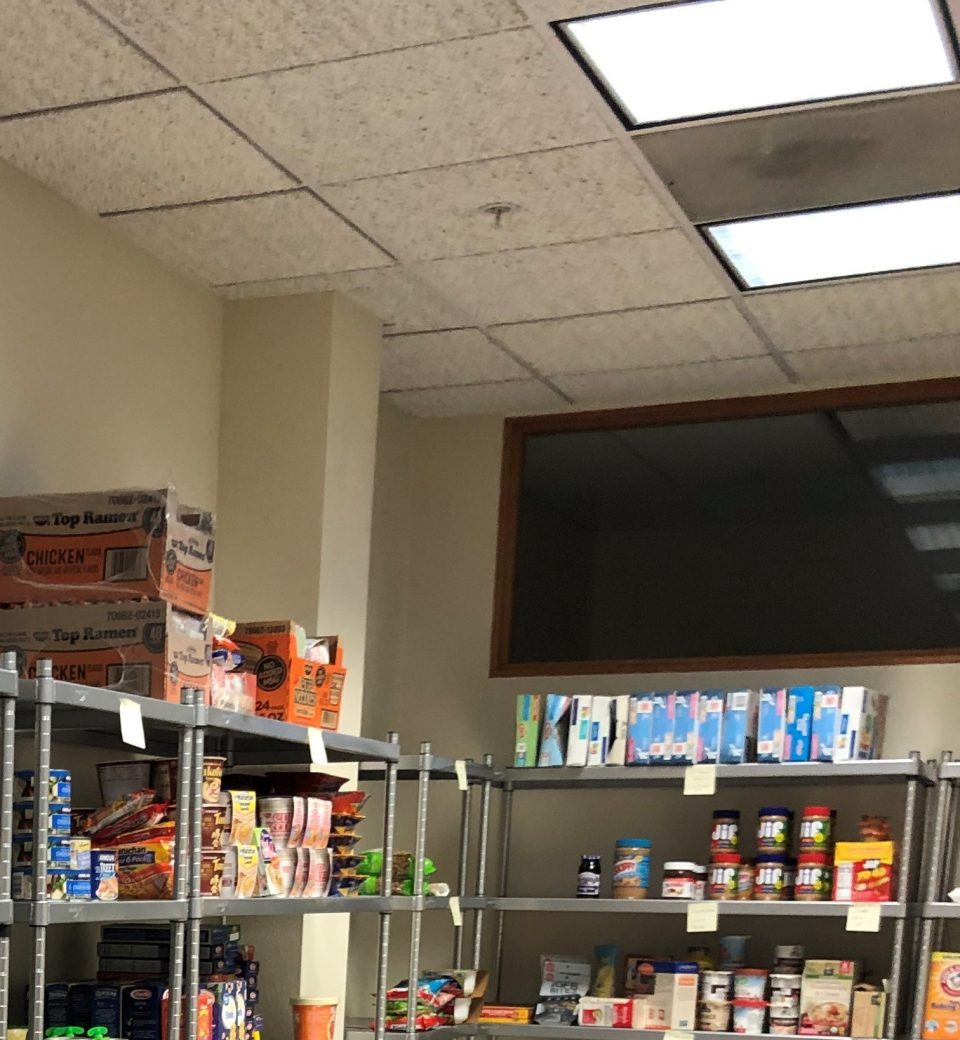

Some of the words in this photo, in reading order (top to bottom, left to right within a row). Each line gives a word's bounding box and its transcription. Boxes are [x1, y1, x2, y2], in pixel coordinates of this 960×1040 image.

[52, 512, 80, 529] Top
[83, 511, 138, 525] Ramen
[27, 549, 86, 566] CHICKEN
[52, 628, 79, 645] Top
[83, 627, 137, 641] Ramen
[28, 664, 87, 681] CCKEN
[256, 701, 270, 712] 24
